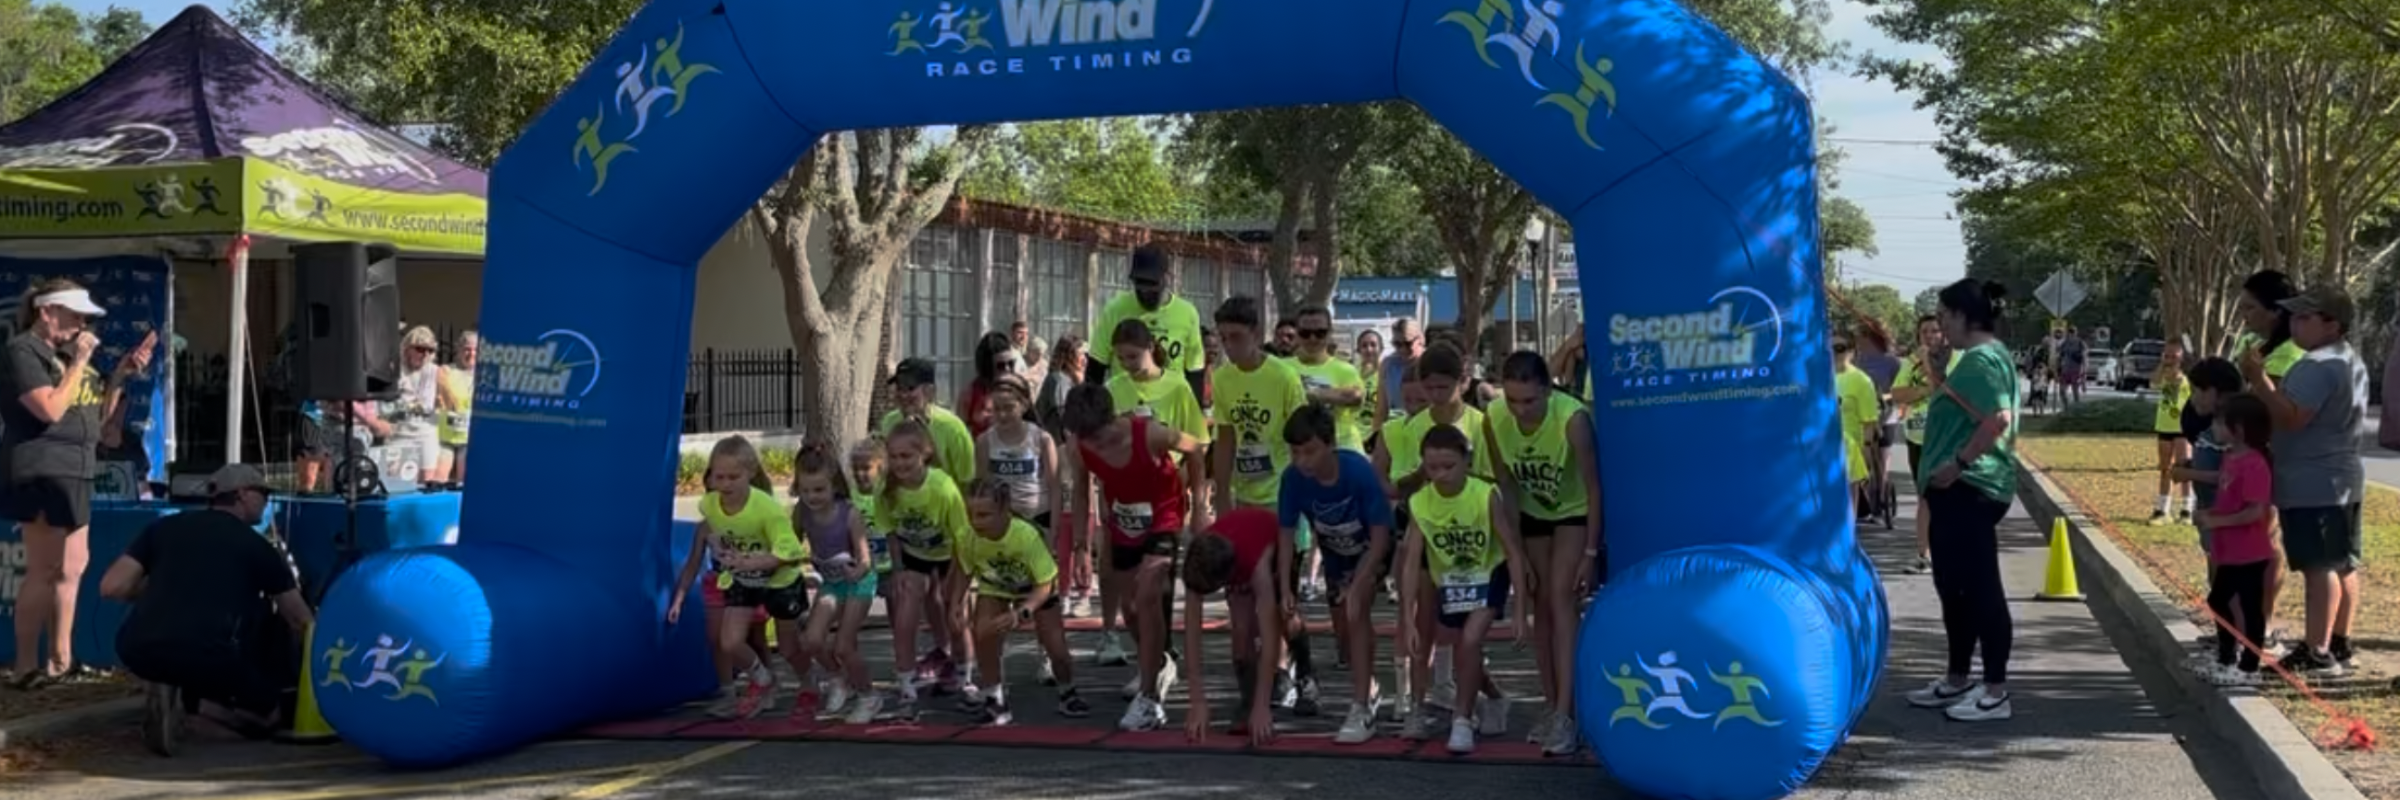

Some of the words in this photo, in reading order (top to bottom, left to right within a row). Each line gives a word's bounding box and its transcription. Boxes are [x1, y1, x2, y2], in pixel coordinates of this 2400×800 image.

[1000, 0, 1156, 47] Wind
[926, 57, 1024, 77] RACE
[1049, 48, 1192, 72] TIMING
[1609, 302, 1733, 345] Second
[1661, 331, 1755, 370] Wind
[499, 366, 573, 396] Wind
[1623, 375, 1674, 388] RACE
[1689, 366, 1771, 383] TIMING
